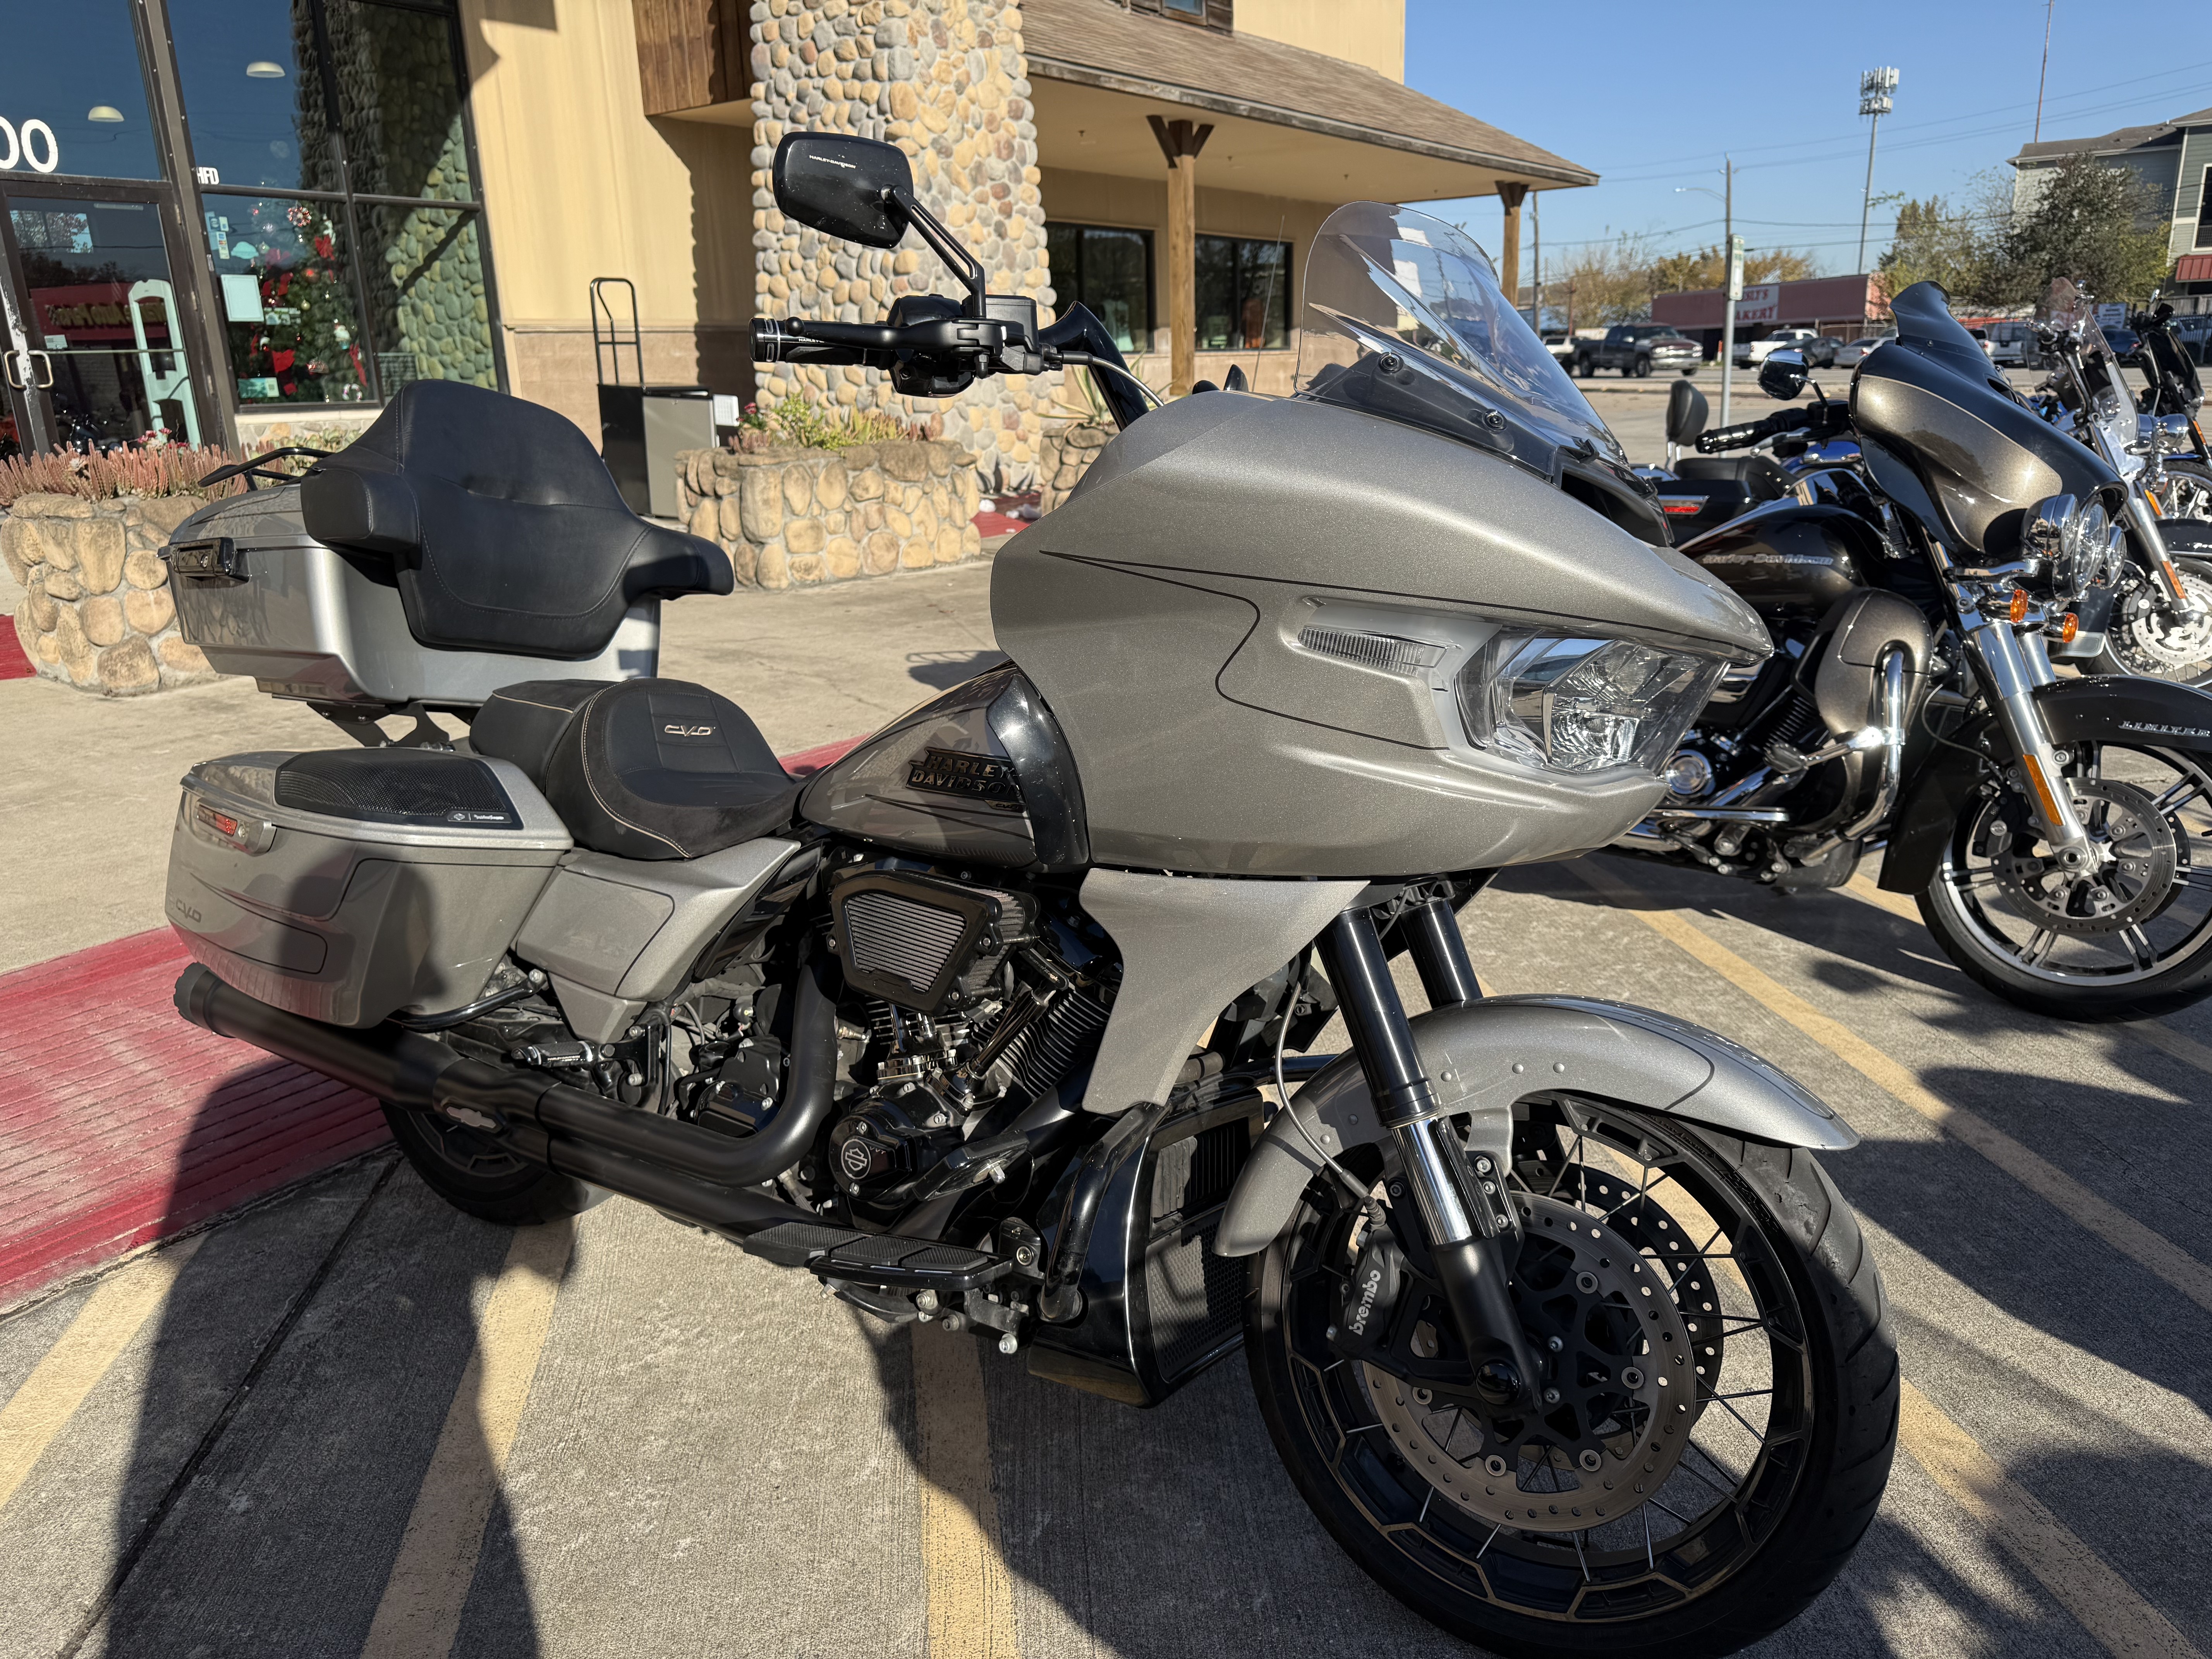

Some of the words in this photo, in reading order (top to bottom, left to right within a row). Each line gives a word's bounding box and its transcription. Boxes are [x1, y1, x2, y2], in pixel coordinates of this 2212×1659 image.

[1735, 304, 1777, 321] AKERY
[664, 725, 713, 737] CVO
[911, 770, 1022, 797] DAVIDSON
[176, 898, 202, 924] CVO
[869, 1146, 886, 1155] VVT
[1348, 1270, 1381, 1336] brembo
